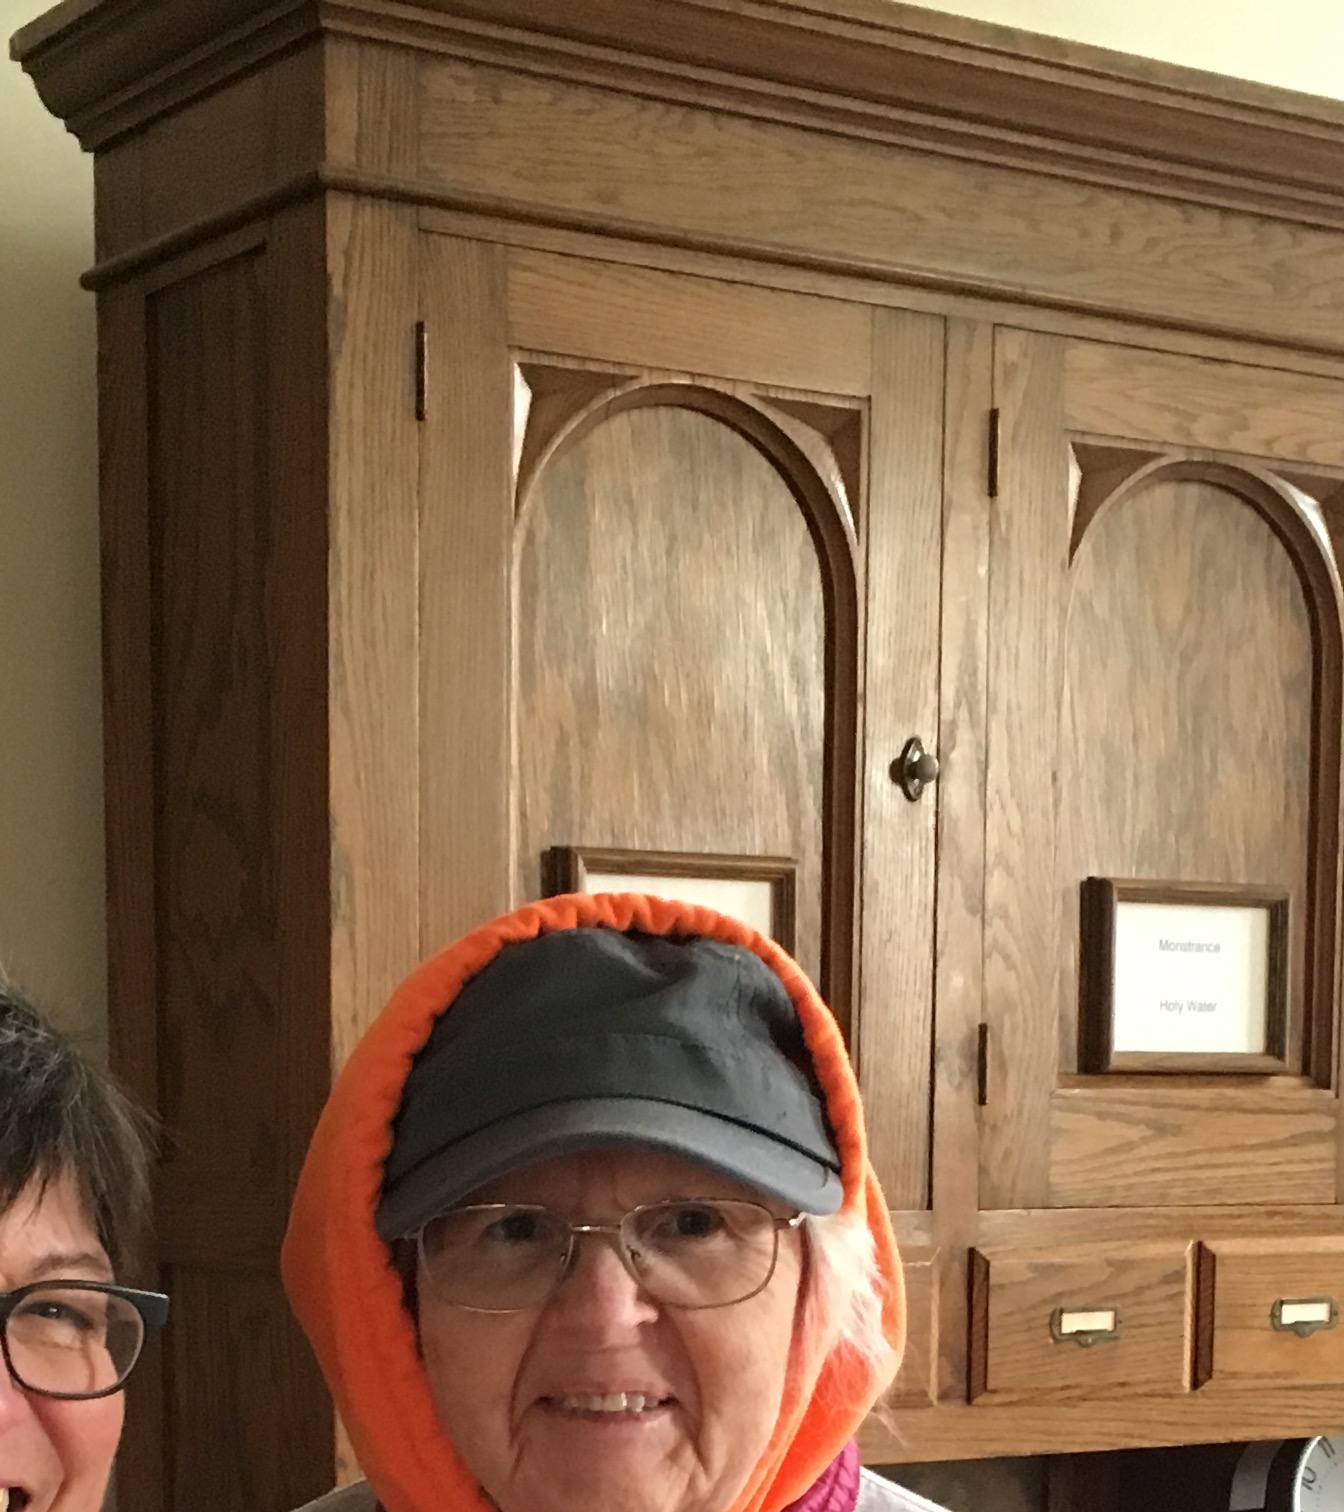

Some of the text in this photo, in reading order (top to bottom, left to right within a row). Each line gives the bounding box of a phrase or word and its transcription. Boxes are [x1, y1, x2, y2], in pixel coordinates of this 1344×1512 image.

[1159, 938, 1221, 953] Monstrance
[1159, 1000, 1218, 1015] Holy Water
[1317, 1436, 1336, 1459] 11
